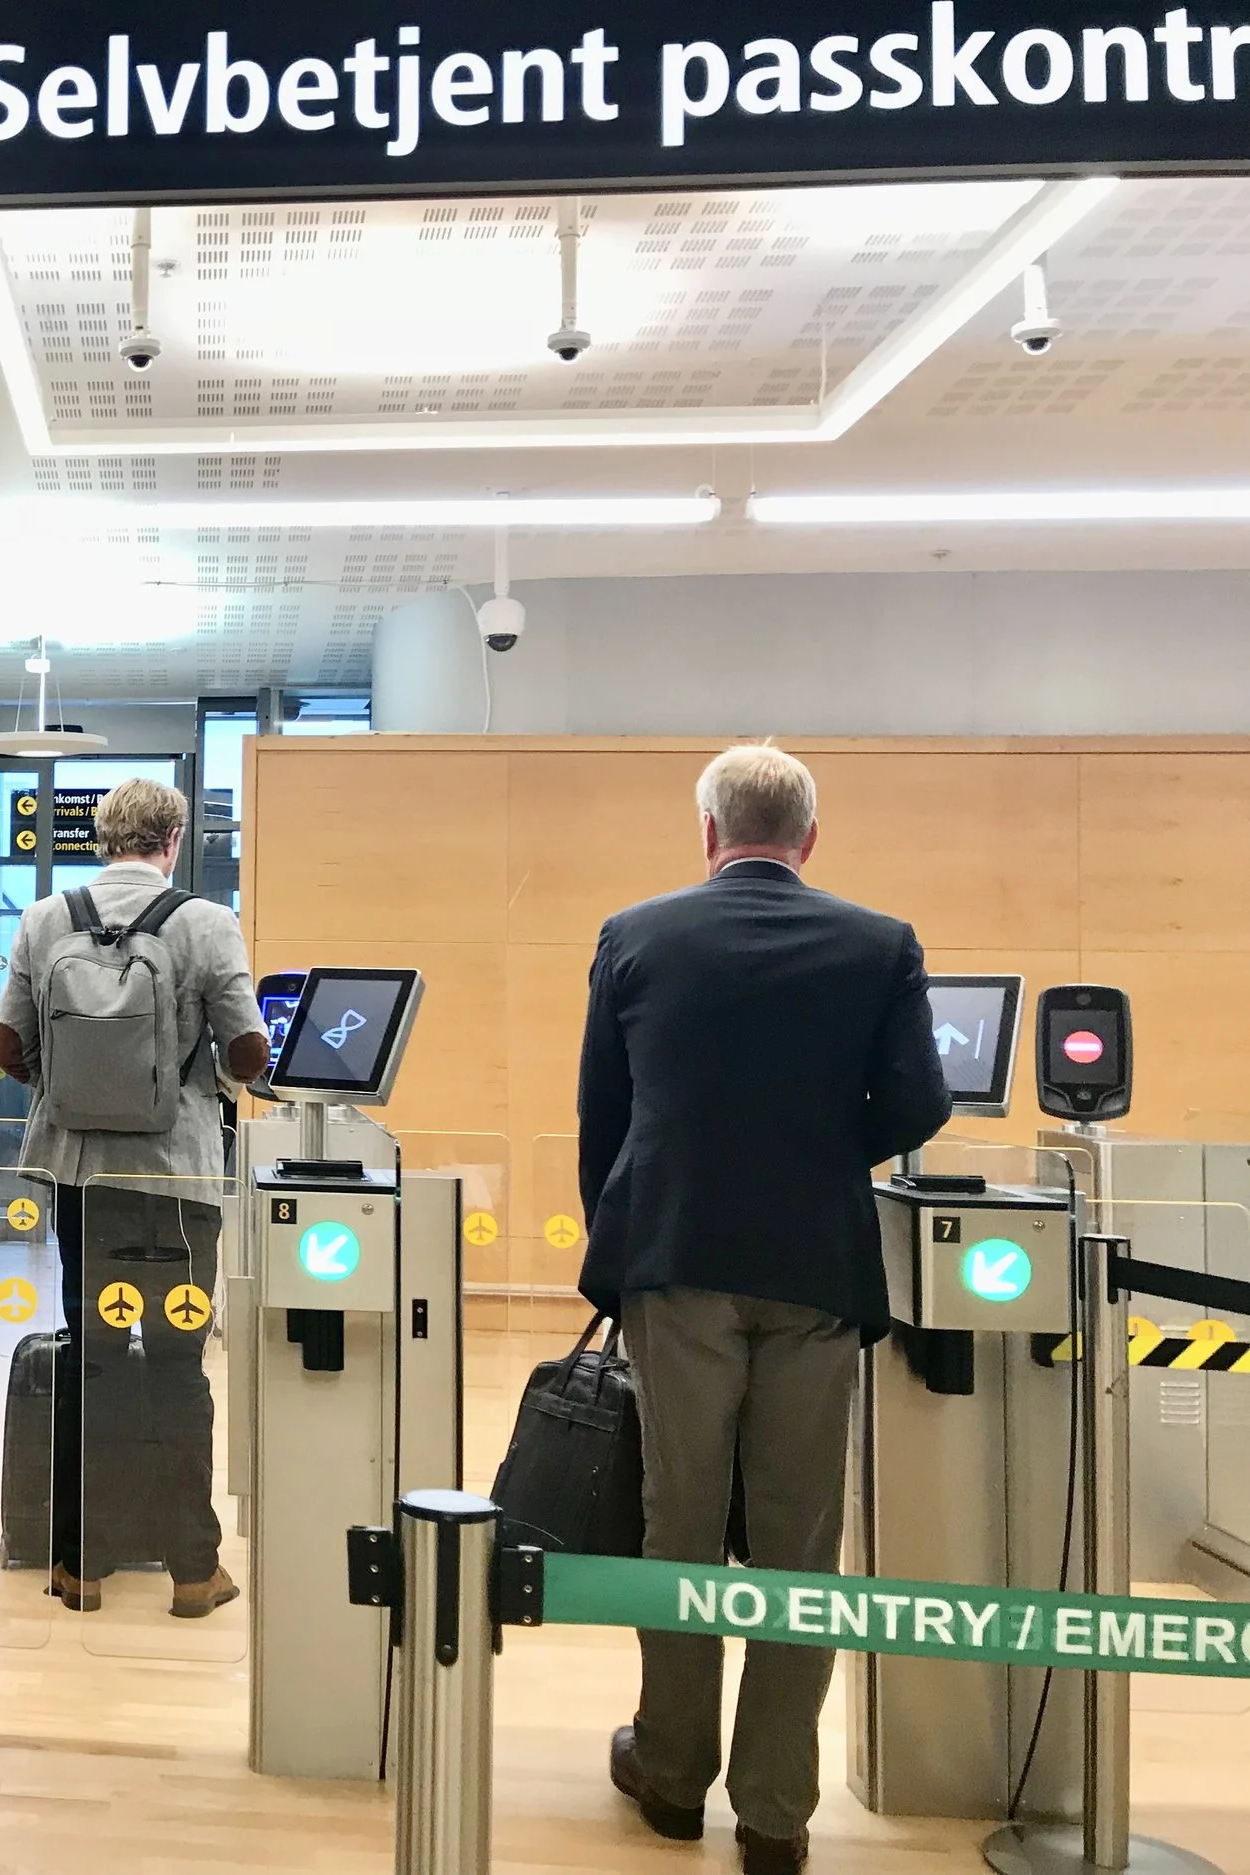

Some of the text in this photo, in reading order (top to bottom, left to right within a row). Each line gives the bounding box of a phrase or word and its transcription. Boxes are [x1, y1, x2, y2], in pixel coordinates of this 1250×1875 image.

[661, 0, 1250, 147] passkontr
[279, 1203, 290, 1219] 8
[941, 1221, 952, 1238] 7
[678, 1577, 1250, 1664] NO ENTRY / EMER
